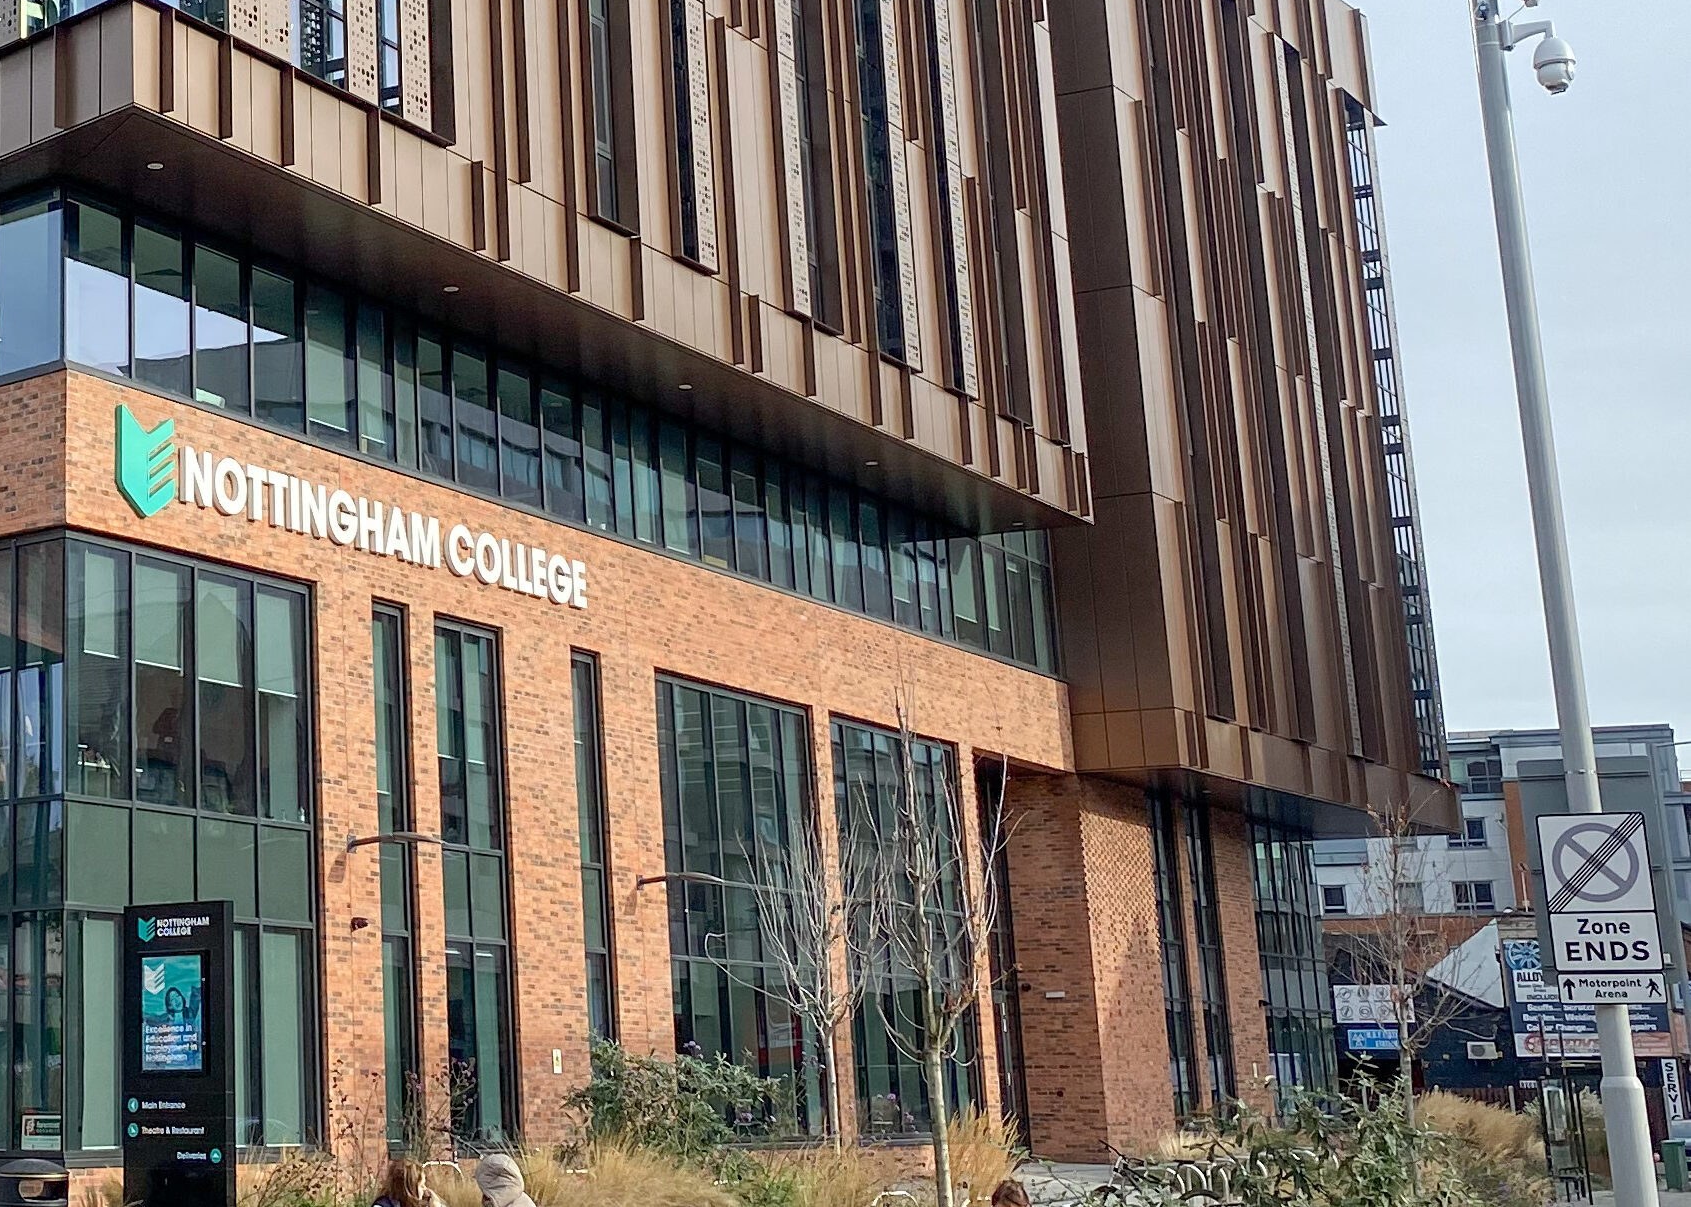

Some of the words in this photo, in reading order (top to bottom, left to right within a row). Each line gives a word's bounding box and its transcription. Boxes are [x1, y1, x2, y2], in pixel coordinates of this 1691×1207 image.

[178, 445, 441, 569] NOTTINGHAM
[443, 523, 588, 609] COLLEGE
[156, 916, 210, 928] NOTTINGHAM
[1577, 918, 1630, 935] Zone
[156, 926, 192, 937] COLLEGE
[1565, 940, 1650, 961] ENDS
[1578, 978, 1642, 989] Motorpoint
[1595, 989, 1628, 998] Arena
[145, 1024, 184, 1034] Excellence
[185, 1023, 193, 1032] in
[1631, 1022, 1657, 1032] epairs
[145, 1033, 182, 1043] Education
[183, 1032, 198, 1042] and
[145, 1043, 189, 1053] Employment
[145, 1053, 188, 1064] Nottingham
[141, 1101, 157, 1110] Main
[158, 1100, 186, 1110] Entrance
[141, 1126, 164, 1135] Theatre
[165, 1126, 170, 1135] &
[171, 1126, 205, 1135] Restaurant
[176, 1151, 207, 1160] Deliveries
